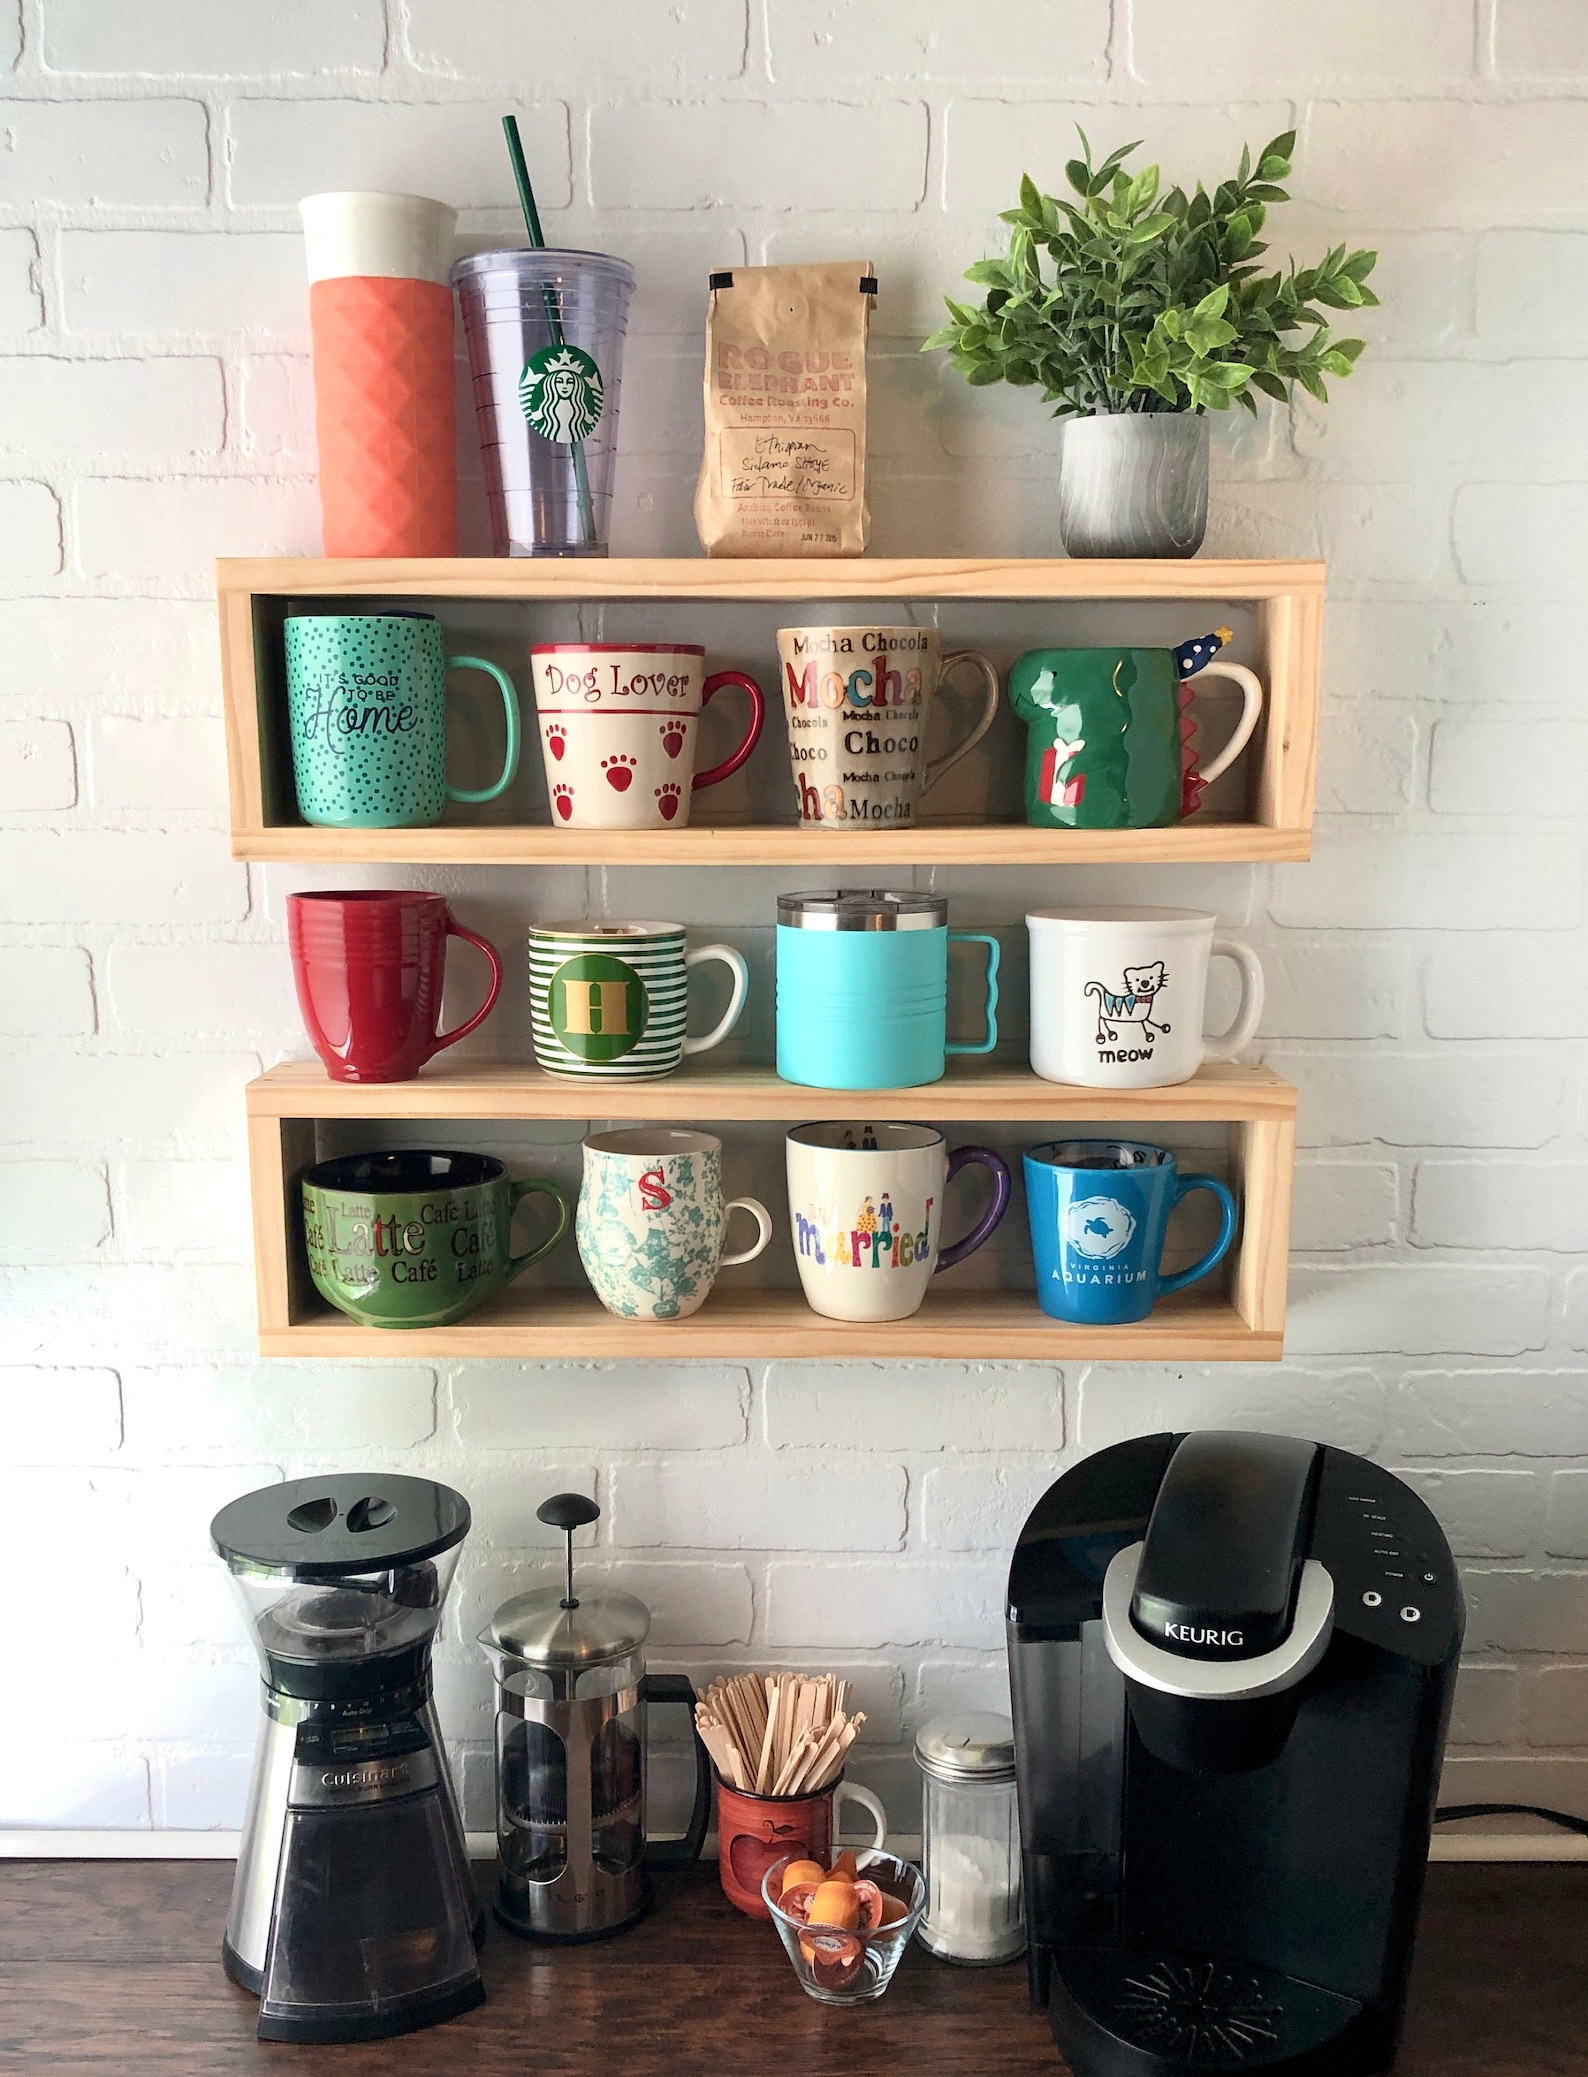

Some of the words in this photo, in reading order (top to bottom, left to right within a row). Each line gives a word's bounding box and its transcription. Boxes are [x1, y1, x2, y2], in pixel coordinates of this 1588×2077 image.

[718, 342, 853, 375] ROGUE
[718, 371, 855, 394] ELEPHANT
[719, 395, 763, 406] Coffee
[832, 397, 854, 407] Co.
[774, 502, 802, 512] Coffee
[794, 634, 854, 655] Mocha
[862, 632, 928, 652] Chocola
[354, 674, 399, 686] GOOD
[545, 664, 602, 703] Dog
[610, 665, 690, 697] Lover
[786, 655, 922, 709] Mocha
[347, 689, 368, 701] TO
[375, 689, 394, 701] BE
[305, 685, 418, 755] Home
[791, 715, 828, 728] Chocola
[842, 710, 881, 721] Mocha
[844, 731, 919, 754] Choco
[842, 771, 880, 783] Mocha
[798, 772, 848, 821] ha
[850, 797, 911, 821] Mocha
[561, 979, 632, 1036] H
[1097, 1047, 1154, 1064] meow
[638, 1166, 671, 1212] S
[341, 1202, 371, 1218] Latte
[421, 1201, 458, 1224] Café
[326, 1206, 425, 1257] Latte
[451, 1220, 496, 1257] Café
[391, 1258, 438, 1283] Café
[1052, 1269, 1148, 1285] AQUARIUM
[1070, 1262, 1129, 1271] VIRGINIA
[1163, 1620, 1244, 1646] KEURIG
[321, 1762, 410, 1786] Cuisinart
